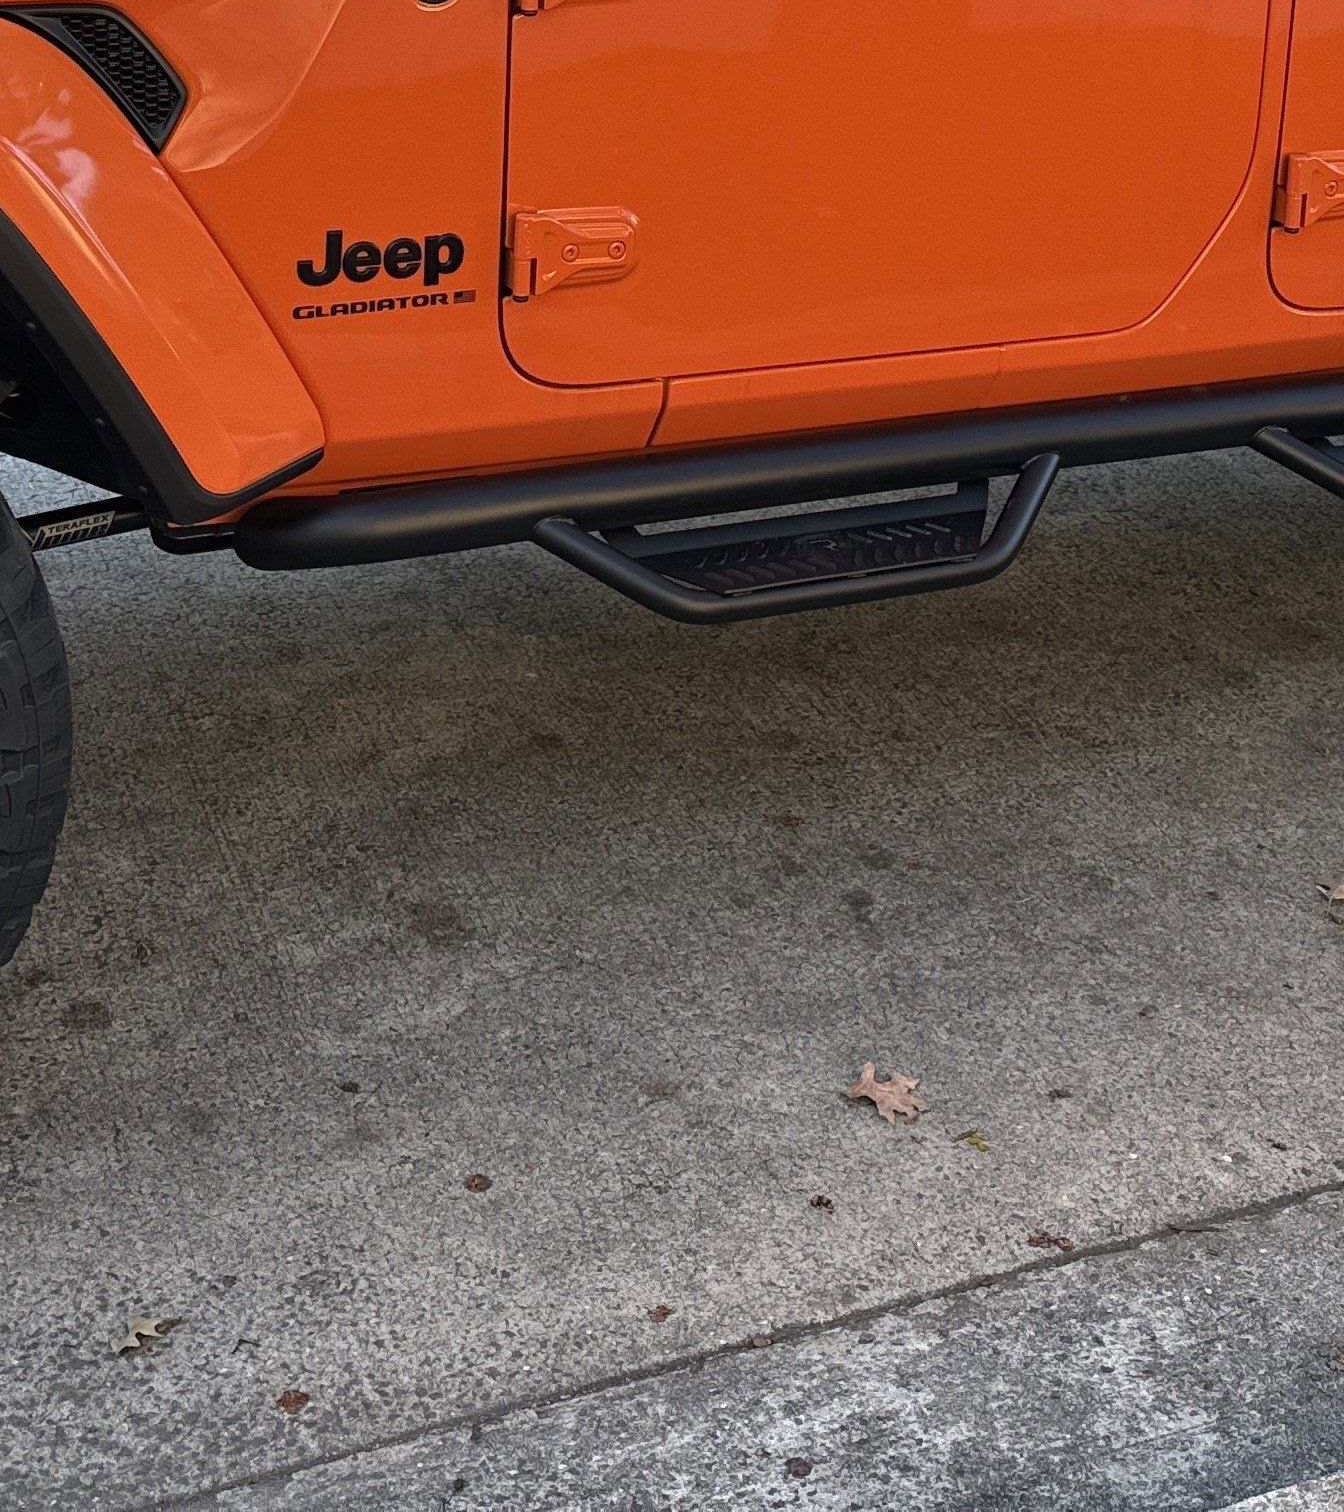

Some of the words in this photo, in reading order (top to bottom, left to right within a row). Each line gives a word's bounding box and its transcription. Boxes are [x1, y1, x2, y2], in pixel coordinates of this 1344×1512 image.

[297, 230, 465, 287] Jeep
[292, 292, 450, 320] GLADIATOR
[47, 514, 111, 534] TERAFLEX
